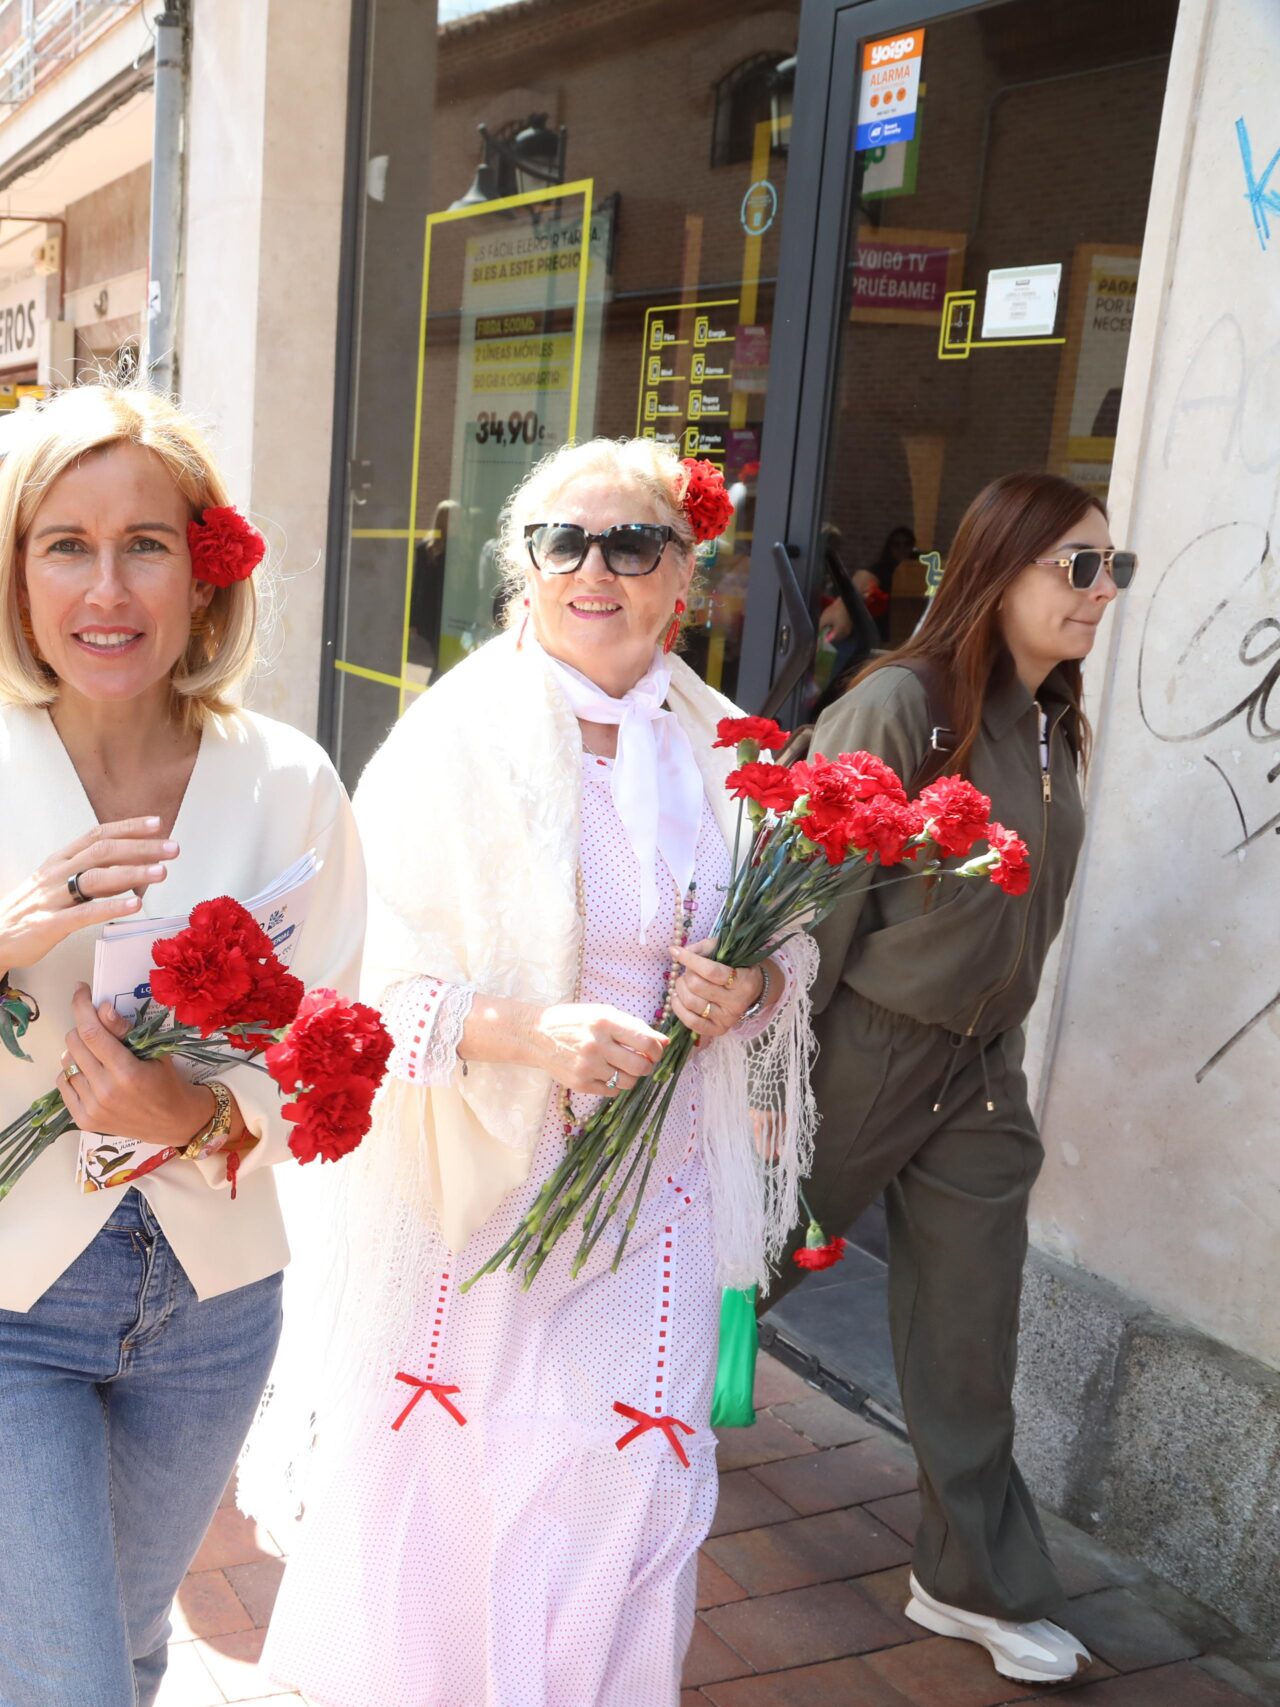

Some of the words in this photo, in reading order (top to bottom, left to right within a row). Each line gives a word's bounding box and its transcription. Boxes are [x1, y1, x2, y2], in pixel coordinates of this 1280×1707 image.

[871, 37, 915, 65] yoigo
[870, 65, 912, 86] ALARMA
[473, 266, 483, 282] SI
[484, 265, 497, 281] ES
[499, 265, 508, 279] A
[510, 258, 534, 277] ESTE
[537, 252, 581, 272] PRECIO
[858, 247, 903, 271] YOIGO
[908, 253, 928, 272] TV
[1096, 297, 1123, 314] POR
